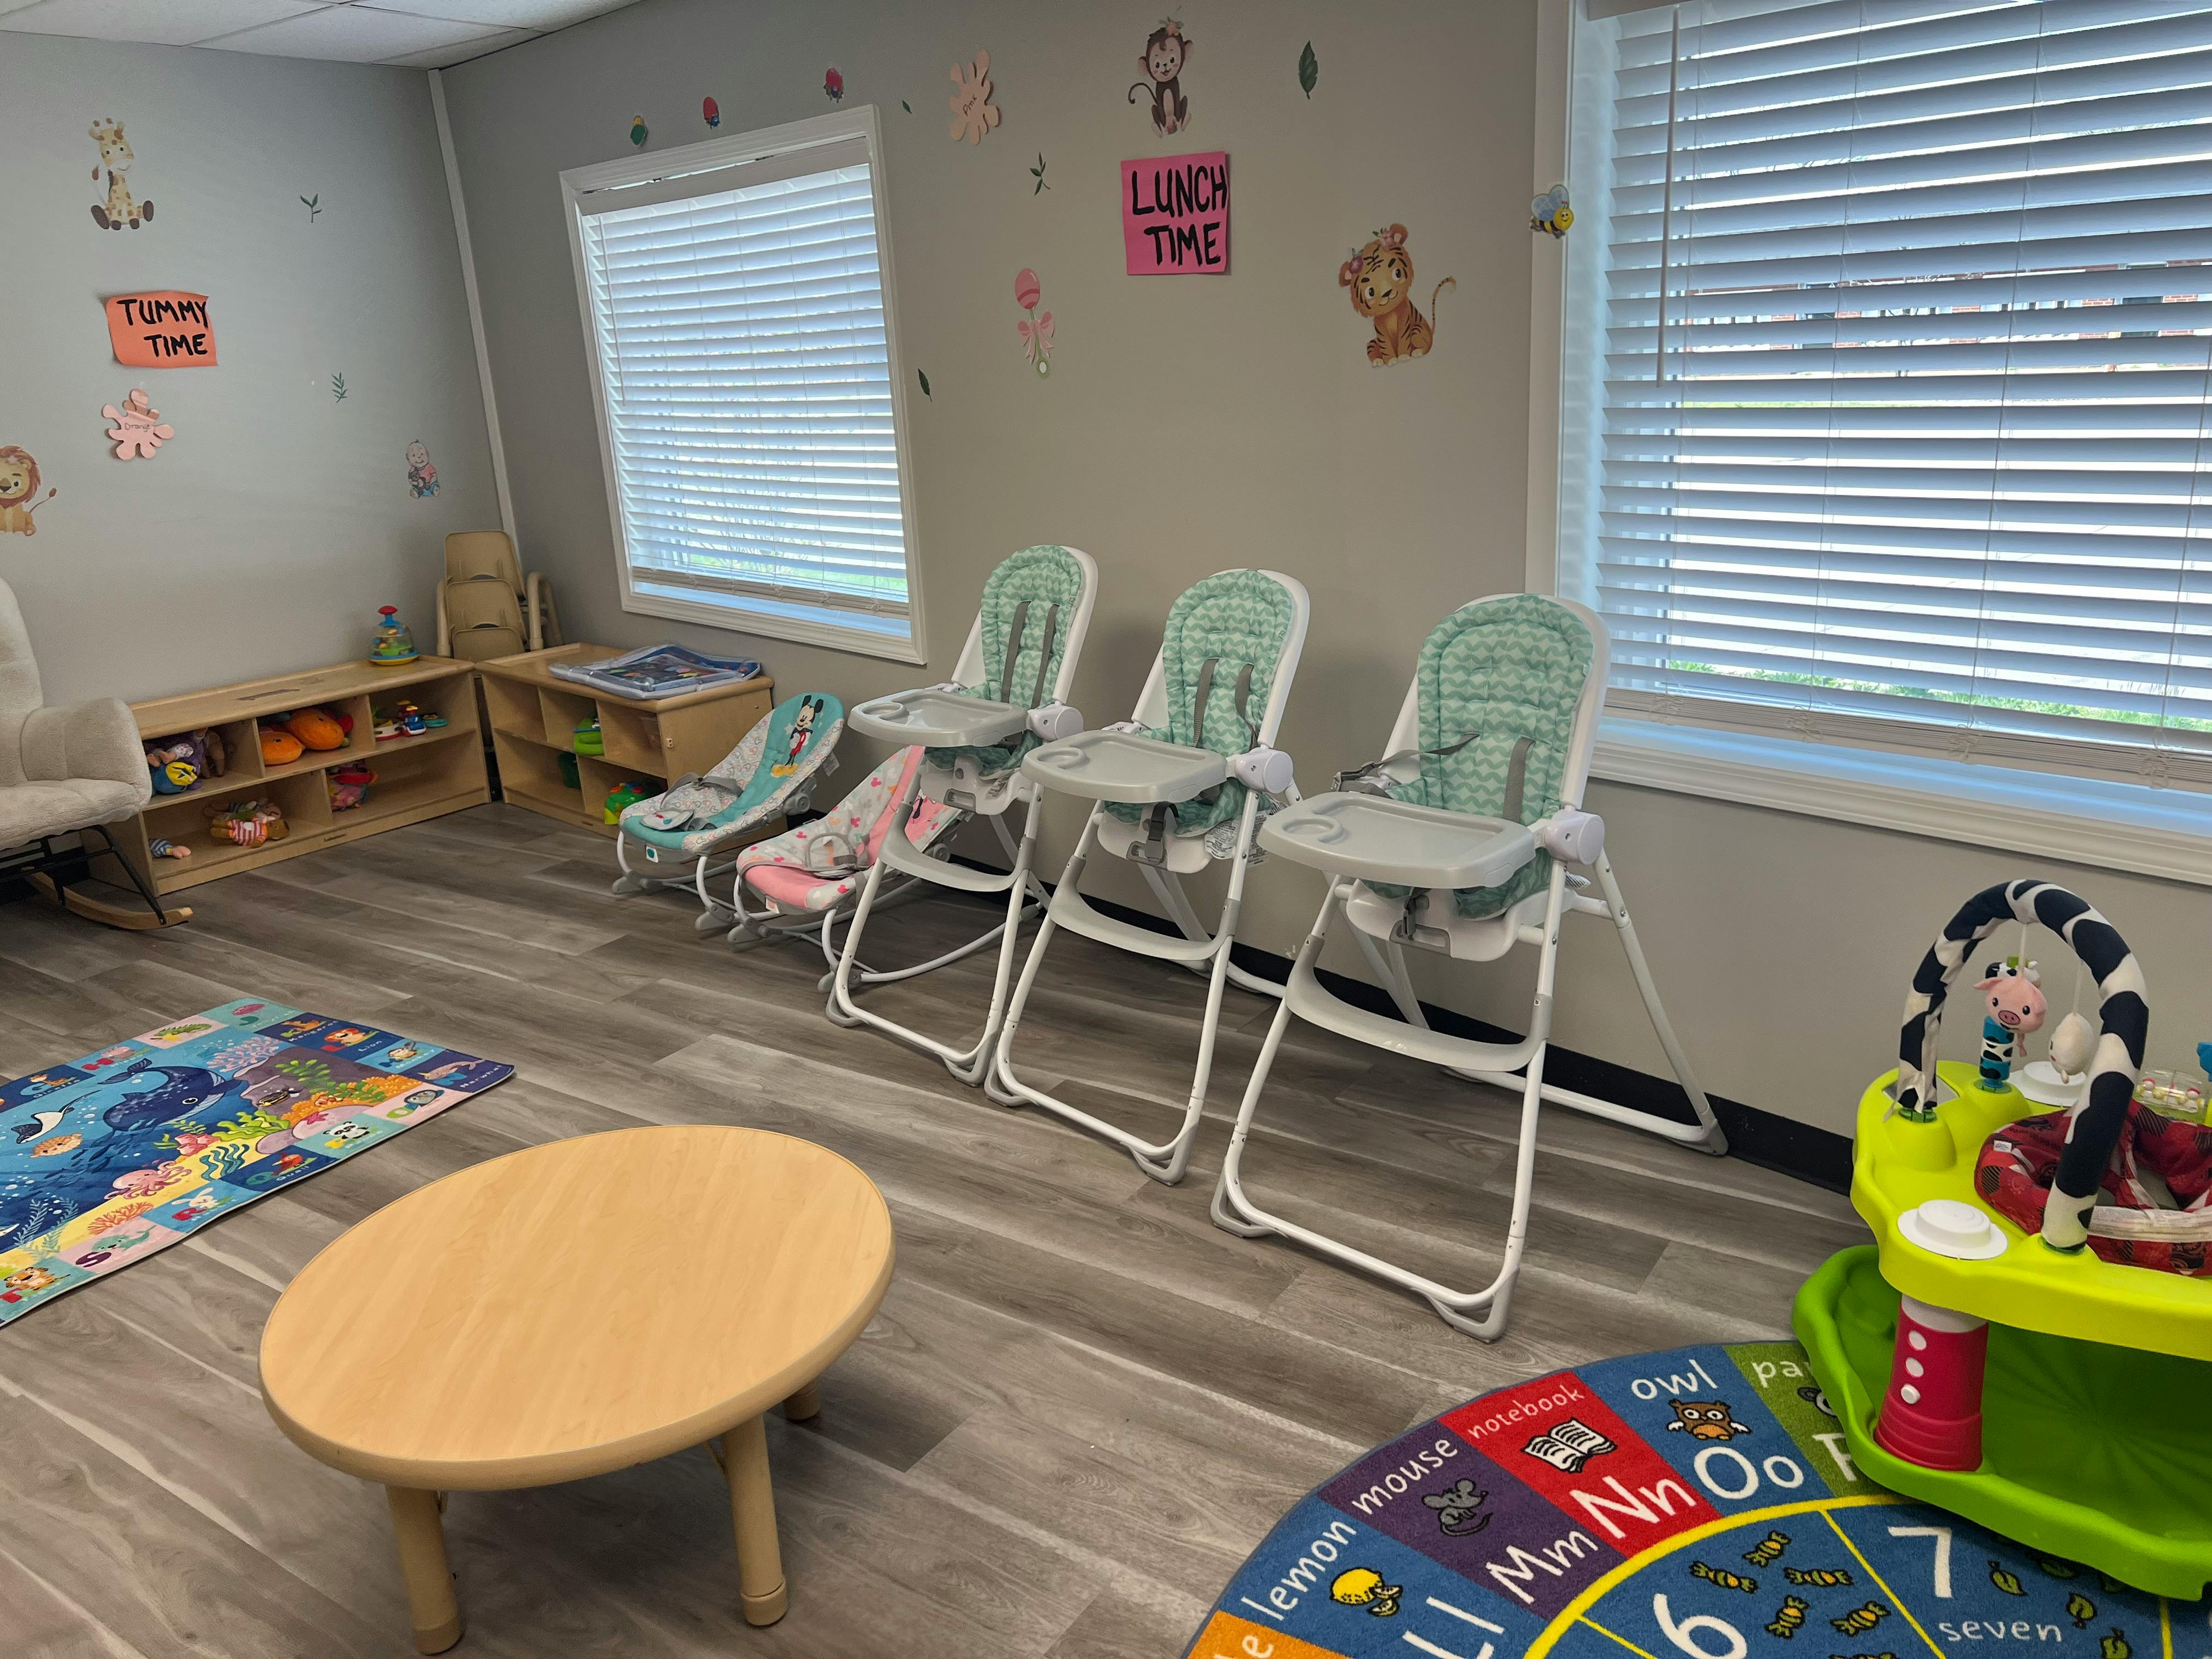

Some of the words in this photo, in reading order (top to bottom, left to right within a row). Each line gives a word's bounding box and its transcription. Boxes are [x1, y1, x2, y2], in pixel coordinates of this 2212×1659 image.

[1132, 164, 1227, 218] LUNCH
[1143, 222, 1221, 266] TIME
[116, 298, 208, 330] TUMMY
[143, 333, 208, 357] TIME
[358, 1040, 382, 1052] Lion
[1630, 1358, 1718, 1400] owl
[1751, 1361, 1810, 1389] pa
[1467, 1381, 1585, 1440] notebook
[1351, 1438, 1459, 1516] mouse
[1693, 1446, 1805, 1500] Oo
[1568, 1475, 1696, 1539] Nn
[1242, 1520, 1357, 1621] lemon
[1485, 1530, 1599, 1605] Mm
[1887, 1526, 1953, 1598] 7
[1653, 1593, 1748, 1659] 6
[1939, 1620, 2062, 1643] seven
